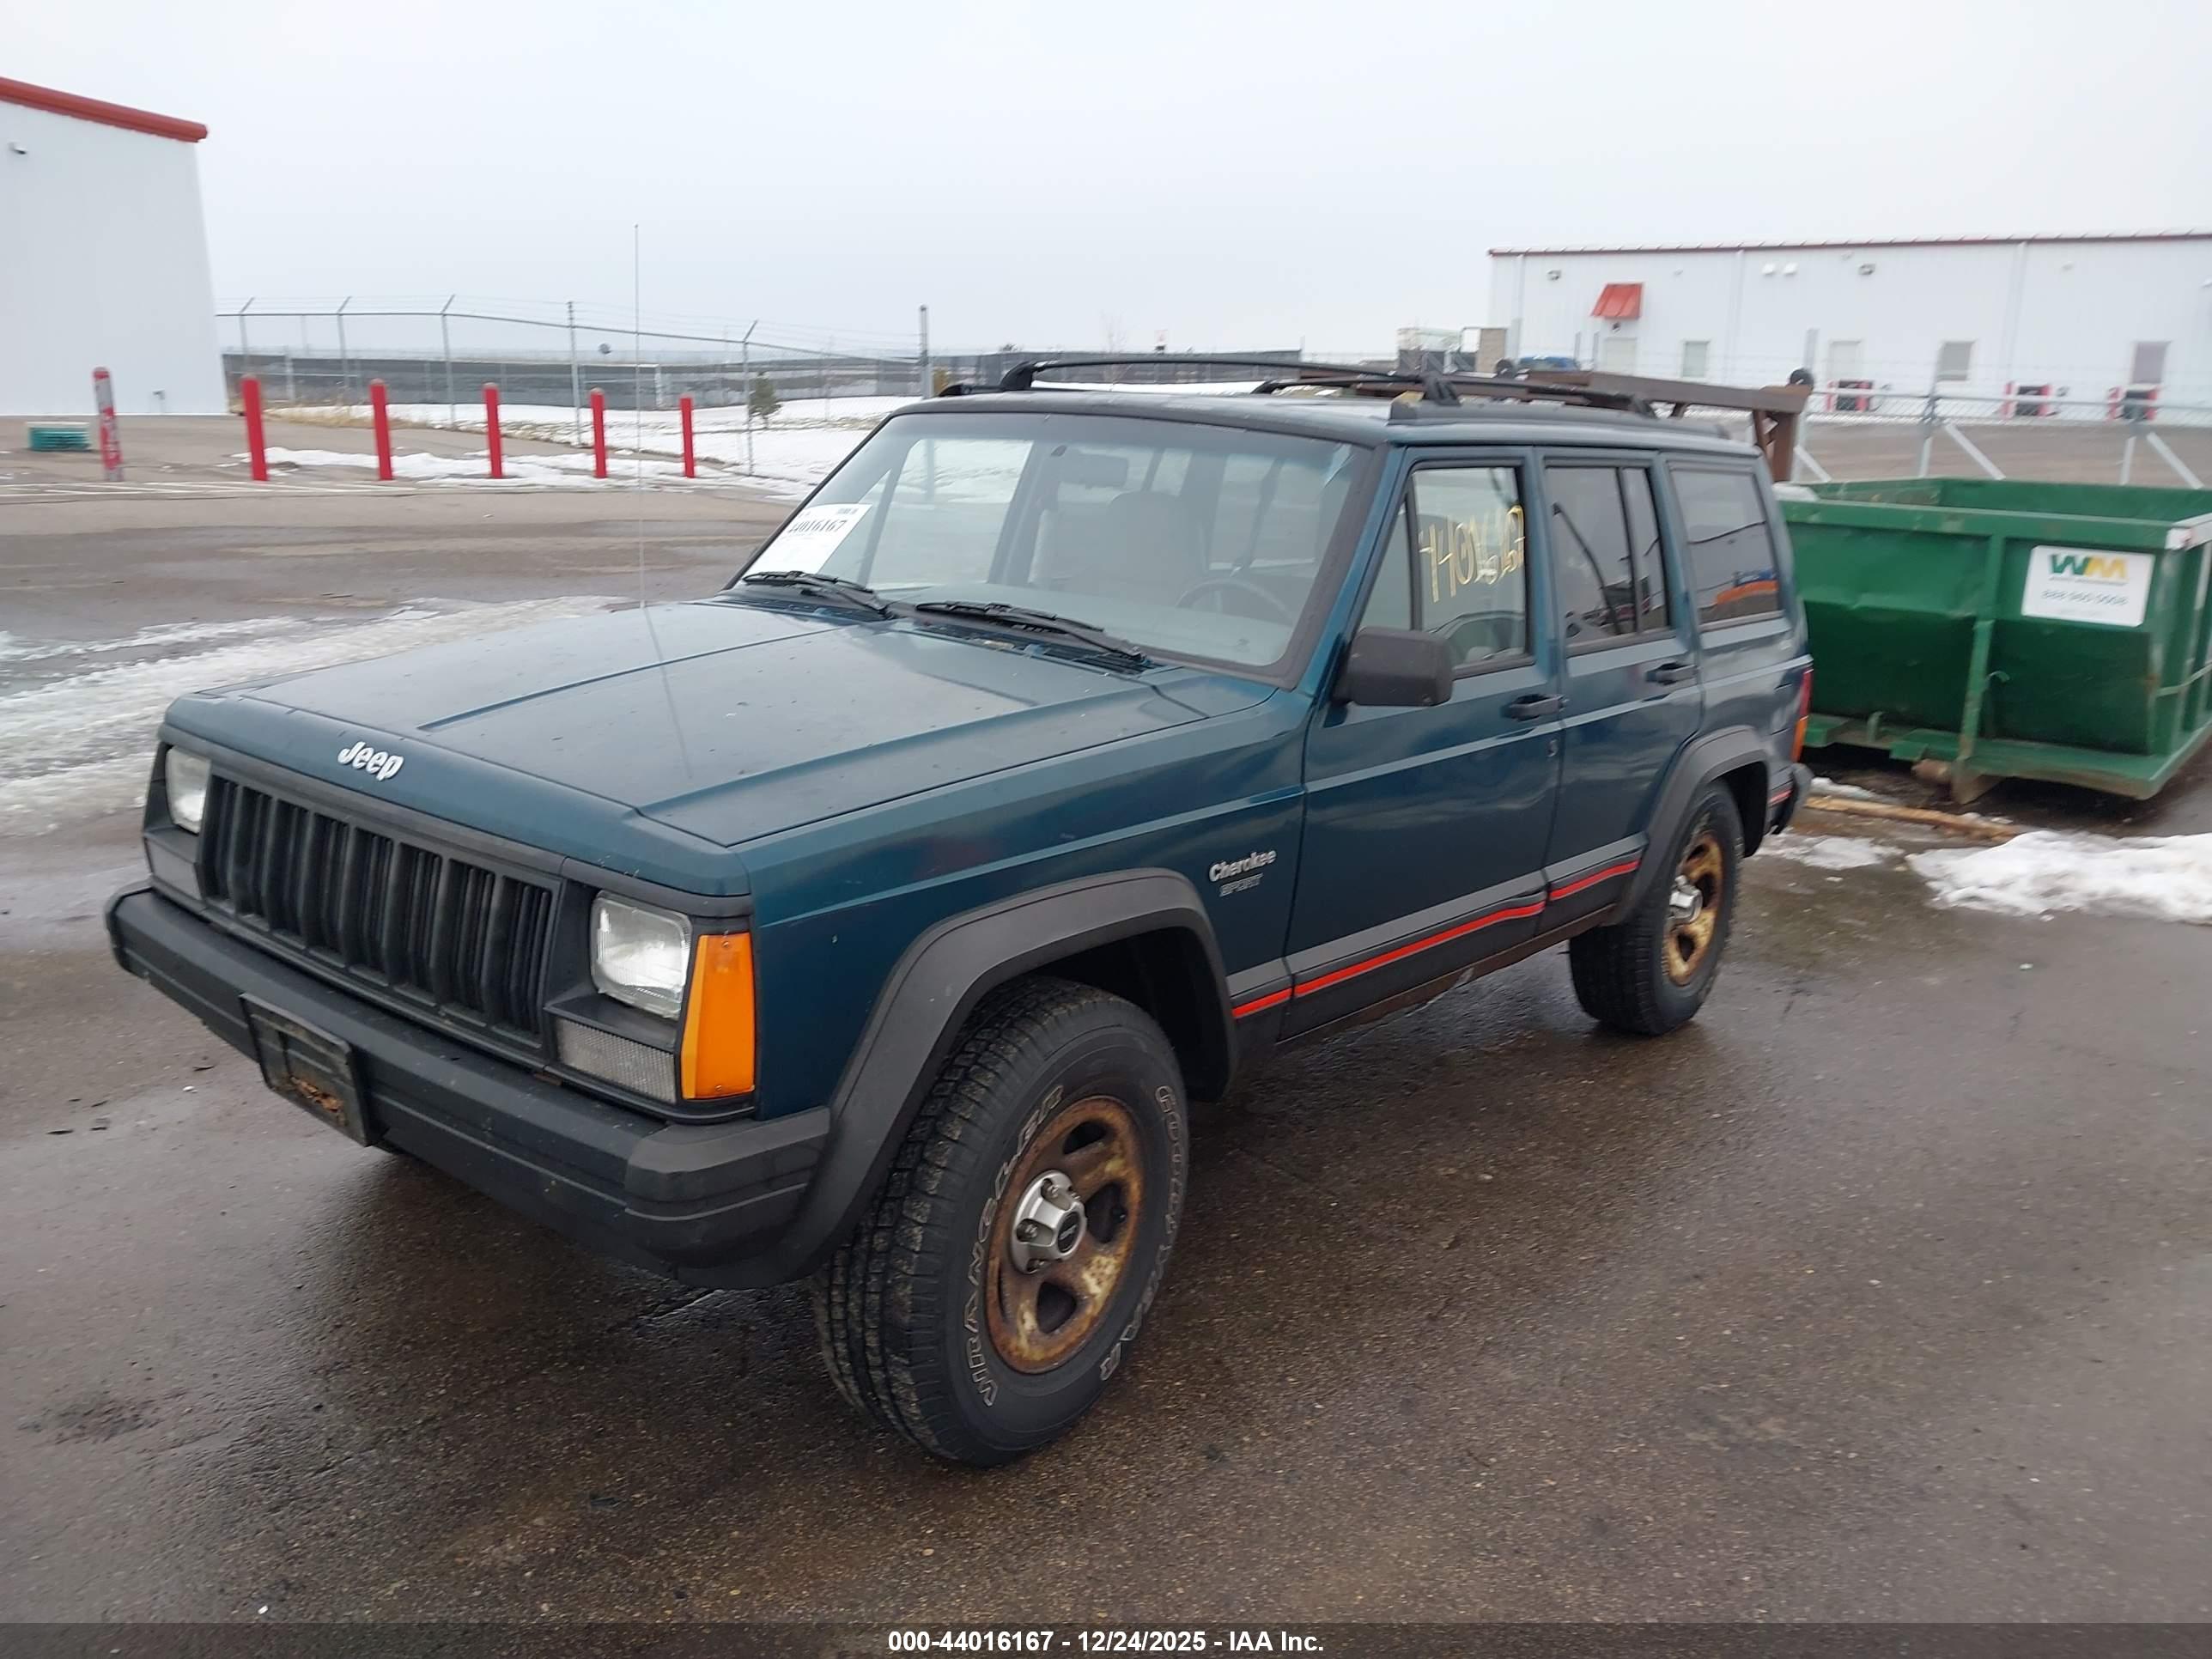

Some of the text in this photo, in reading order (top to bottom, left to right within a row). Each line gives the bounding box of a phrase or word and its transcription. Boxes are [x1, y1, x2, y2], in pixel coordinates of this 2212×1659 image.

[2051, 554, 2126, 578] WM
[337, 741, 404, 781] Jeep
[1208, 850, 1277, 882] Cherokee
